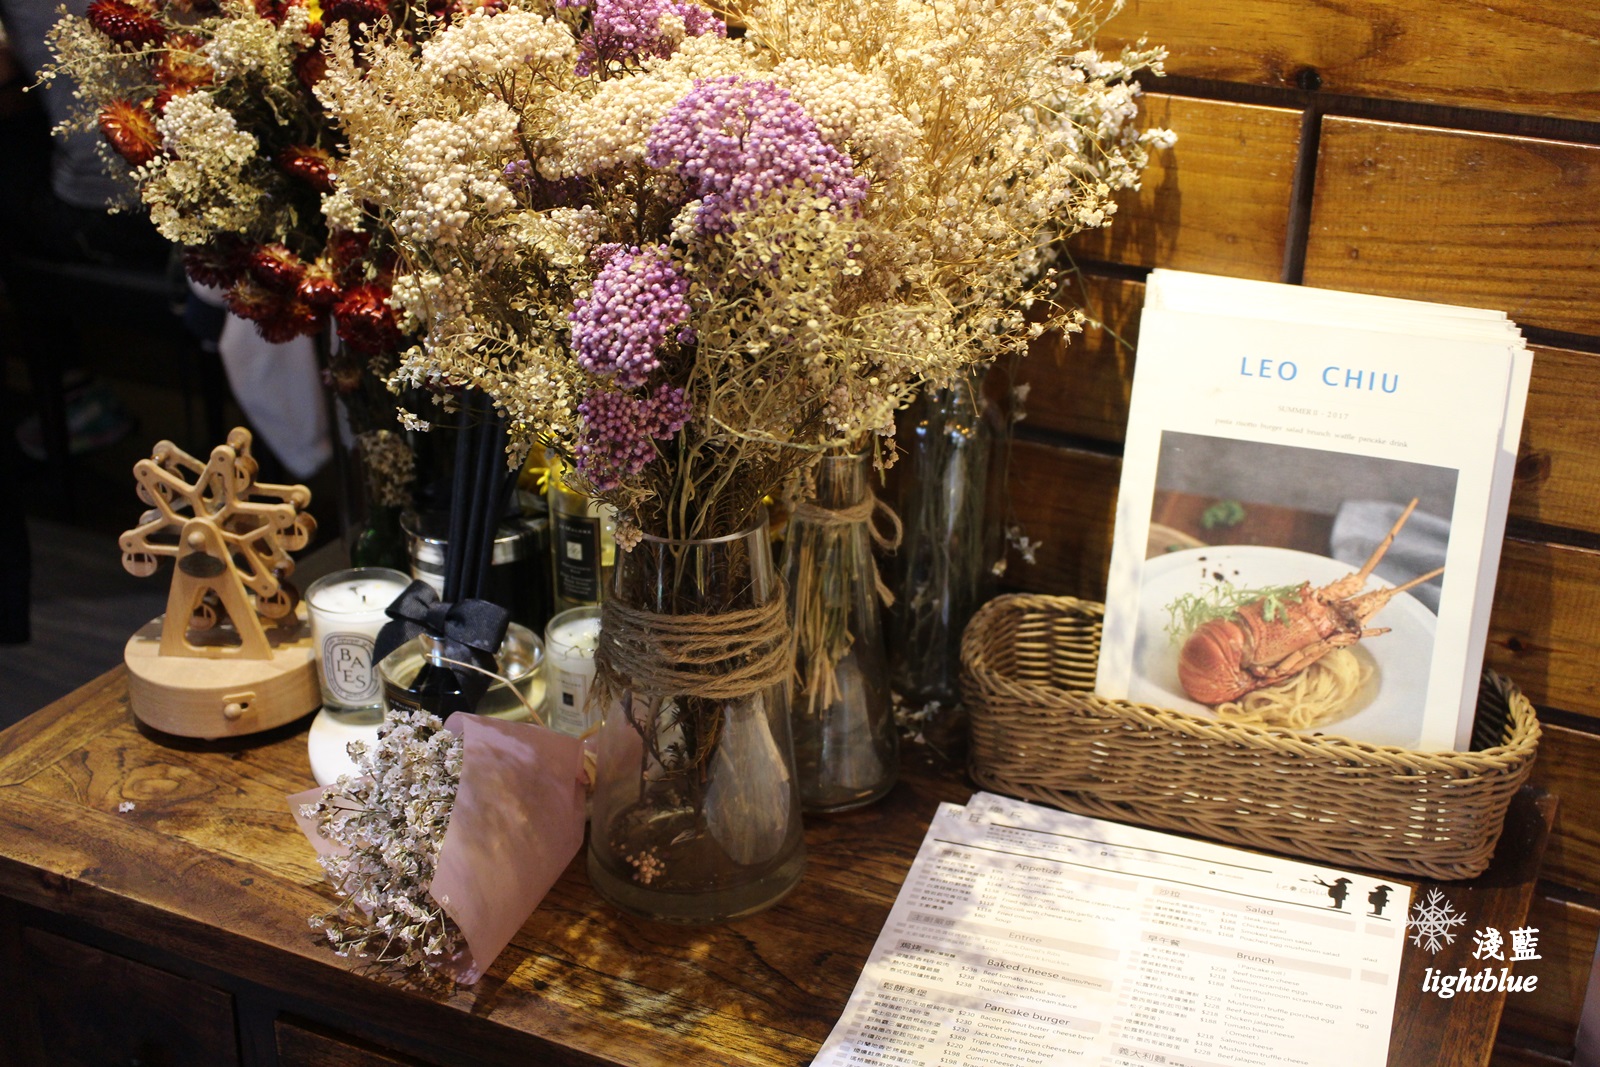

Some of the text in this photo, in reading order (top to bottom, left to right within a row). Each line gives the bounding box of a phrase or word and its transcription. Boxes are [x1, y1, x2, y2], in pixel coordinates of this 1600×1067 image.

[1240, 356, 1399, 394] LEO CHIU
[1277, 405, 1312, 416] SUMMER
[1326, 411, 1350, 420] 2017
[1358, 435, 1387, 446] pancake
[1389, 439, 1409, 449] drink
[1014, 862, 1064, 878] Appetizer
[1244, 904, 1274, 916] Salad
[1241, 921, 1268, 931] Chicken
[1007, 931, 1043, 944] Entree
[1238, 935, 1268, 944] Poached
[1283, 943, 1321, 954] mushroom
[1240, 928, 1268, 937] Smoked
[1268, 933, 1293, 942] salmon
[1294, 938, 1312, 946] salad
[1235, 951, 1275, 965] Brunch
[985, 958, 1020, 971] Baked
[1020, 965, 1060, 979] cheese
[1210, 965, 1300, 987] $228 Beef tomato cheese
[881, 981, 928, 997] 鬆餅漢堡
[979, 977, 1003, 986] Grilled
[1002, 981, 1029, 991] chicken
[1046, 990, 1067, 998] sauce
[998, 973, 1024, 982] tomato
[1023, 978, 1044, 986] sauce
[1208, 972, 1308, 996] $218 Salmon scramble eggs
[954, 980, 972, 988] $238
[992, 987, 1019, 997] chicken
[1018, 992, 1035, 1000] with
[1034, 996, 1057, 1005] cream
[1057, 1000, 1078, 1009] sauce
[1230, 984, 1251, 992] Bacon
[1252, 988, 1291, 1000] mushroom
[1291, 995, 1324, 1006] scramble
[1324, 1002, 1343, 1010] eggs
[983, 1002, 1071, 1028] Pancake burger
[1204, 994, 1222, 1002] $228
[1227, 999, 1266, 1011] Mushroom
[1267, 1006, 1289, 1015] truffle
[1289, 1010, 1319, 1021] porched
[1225, 1006, 1242, 1014] Beef
[1242, 1009, 1259, 1017] basil
[1260, 1013, 1285, 1022] cheese
[954, 1017, 1045, 1040] $230 Omelet cheese beef
[957, 1010, 1094, 1041] $230 Bacon peanut butter cheese beef
[1199, 1016, 1295, 1040] $188 Tomato basil cheese
[1201, 1009, 1285, 1030] $218 Chicken jalapeno
[948, 1033, 1054, 1059] $388 Triple cheese triple beef
[951, 1025, 1084, 1056] $230 Jack Daniel's bacon cheese beef
[1196, 1032, 1274, 1051] $218 Salmon cheese
[939, 1057, 957, 1065] $198
[942, 1049, 961, 1057] $198
[964, 1053, 989, 1063] Cumin
[989, 1058, 1015, 1067] cheese
[945, 1041, 964, 1049] $220
[967, 1045, 1000, 1057] Jalapeno
[999, 1052, 1025, 1061] cheese
[1025, 1057, 1043, 1065] beef
[1117, 1046, 1167, 1064] 義大利麵
[1193, 1047, 1266, 1067] $228 Beef jalapeno
[1195, 1039, 1309, 1067] $188 Mushroom truffle cheese
